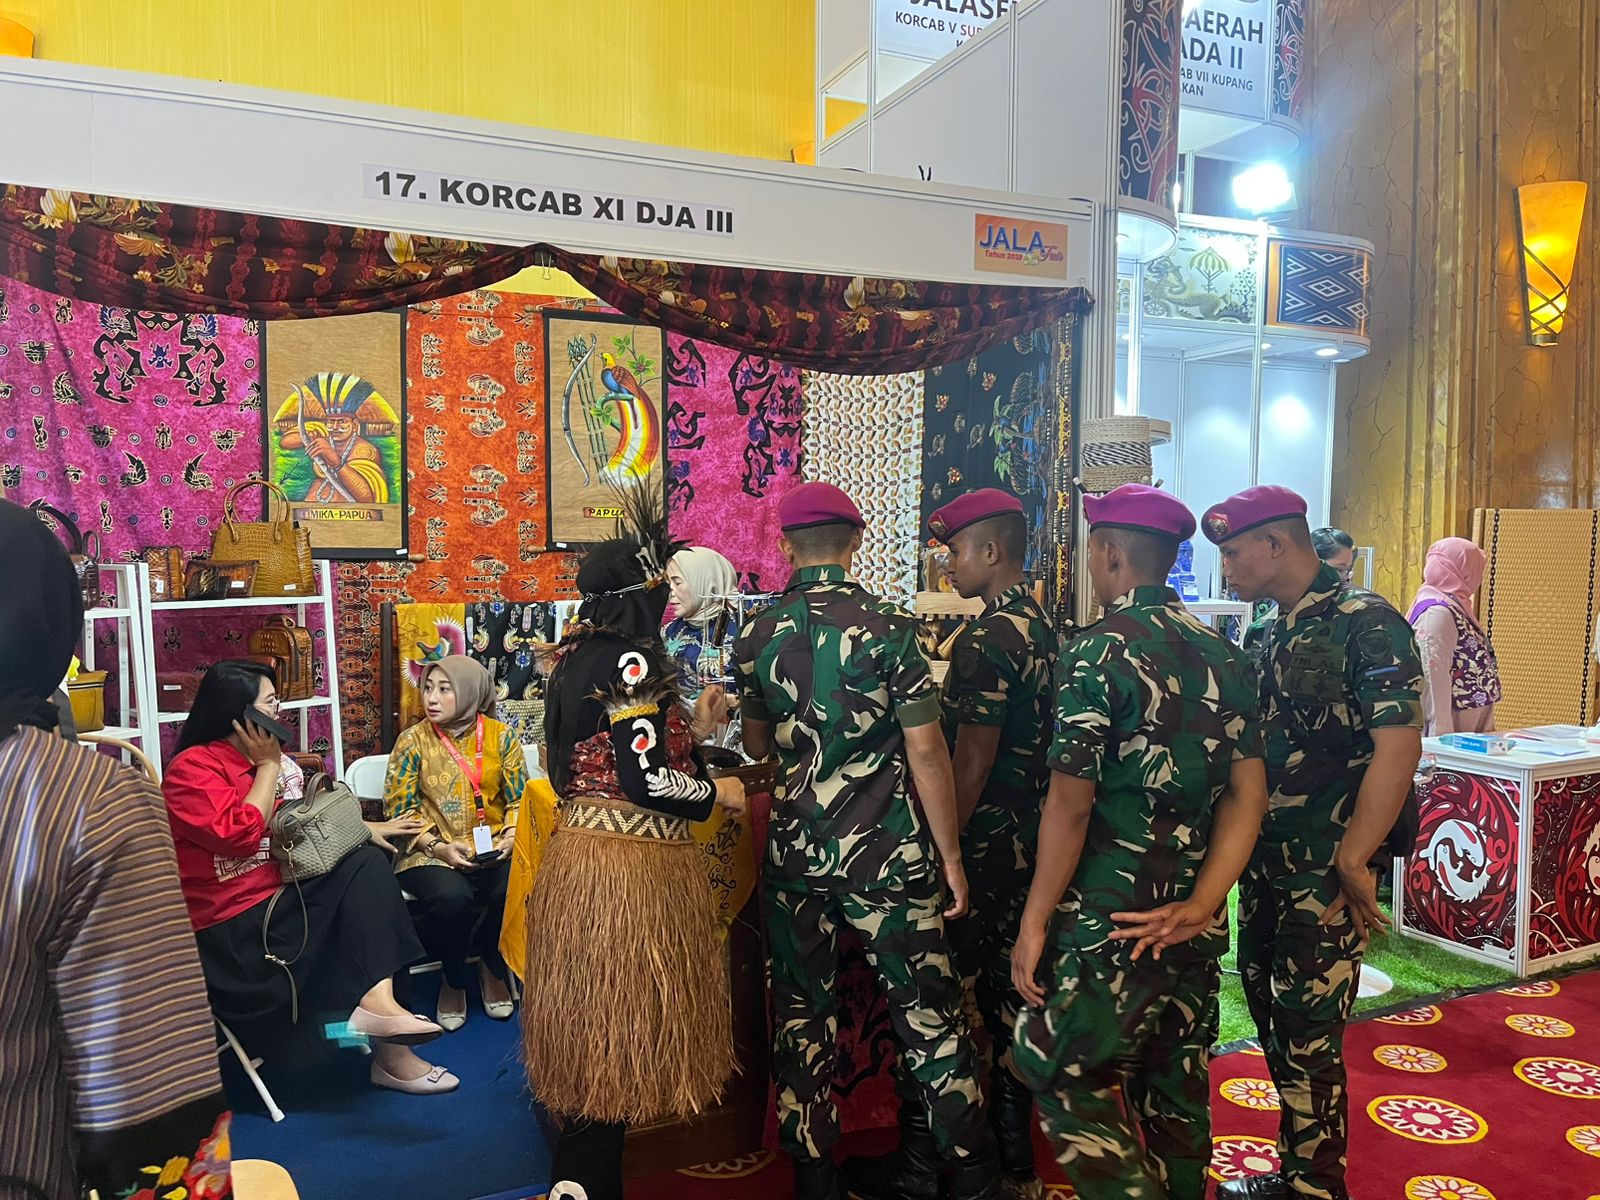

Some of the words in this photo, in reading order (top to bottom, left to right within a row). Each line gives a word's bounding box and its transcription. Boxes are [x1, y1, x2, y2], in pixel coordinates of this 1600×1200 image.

[910, 0, 1009, 20] LASE
[895, 11, 945, 32] KORCAB
[949, 22, 957, 34] V
[1184, 7, 1263, 44] AERAH
[1230, 45, 1243, 70] II
[1181, 83, 1204, 97] KAN
[1195, 70, 1209, 83] VII
[1212, 73, 1253, 91] KUPANG
[374, 170, 427, 199] 17.
[440, 178, 583, 217] KORCAB
[593, 196, 624, 221] XI
[636, 201, 696, 229] DJA
[706, 209, 733, 234] III
[979, 224, 1045, 253] JALA
[985, 249, 1006, 260] Tahun
[588, 508, 625, 517] PAPUA
